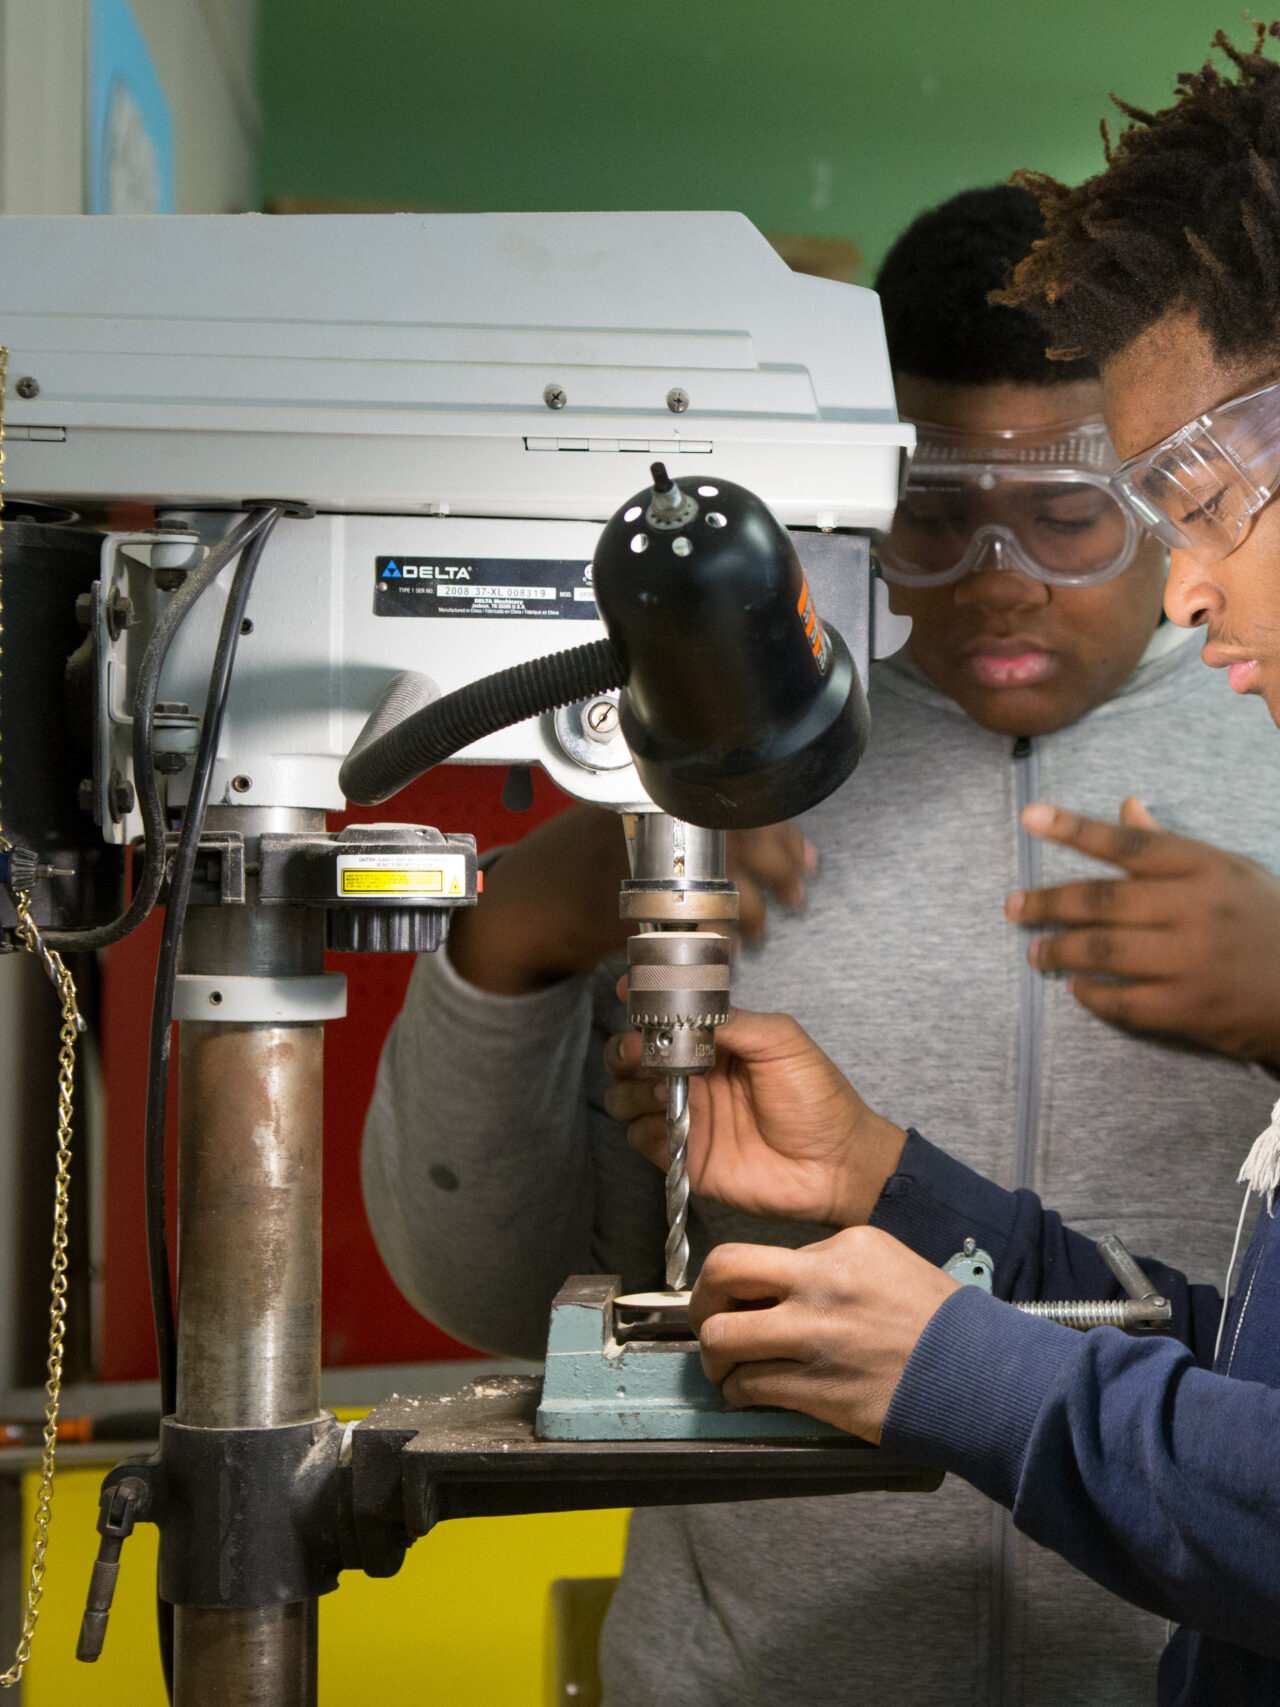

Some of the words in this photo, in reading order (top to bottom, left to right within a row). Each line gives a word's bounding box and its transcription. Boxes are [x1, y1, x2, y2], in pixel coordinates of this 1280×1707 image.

[402, 565, 471, 580] DELTA
[445, 586, 470, 596] 2008
[475, 587, 503, 597] 37-XL
[507, 588, 546, 598] 008319
